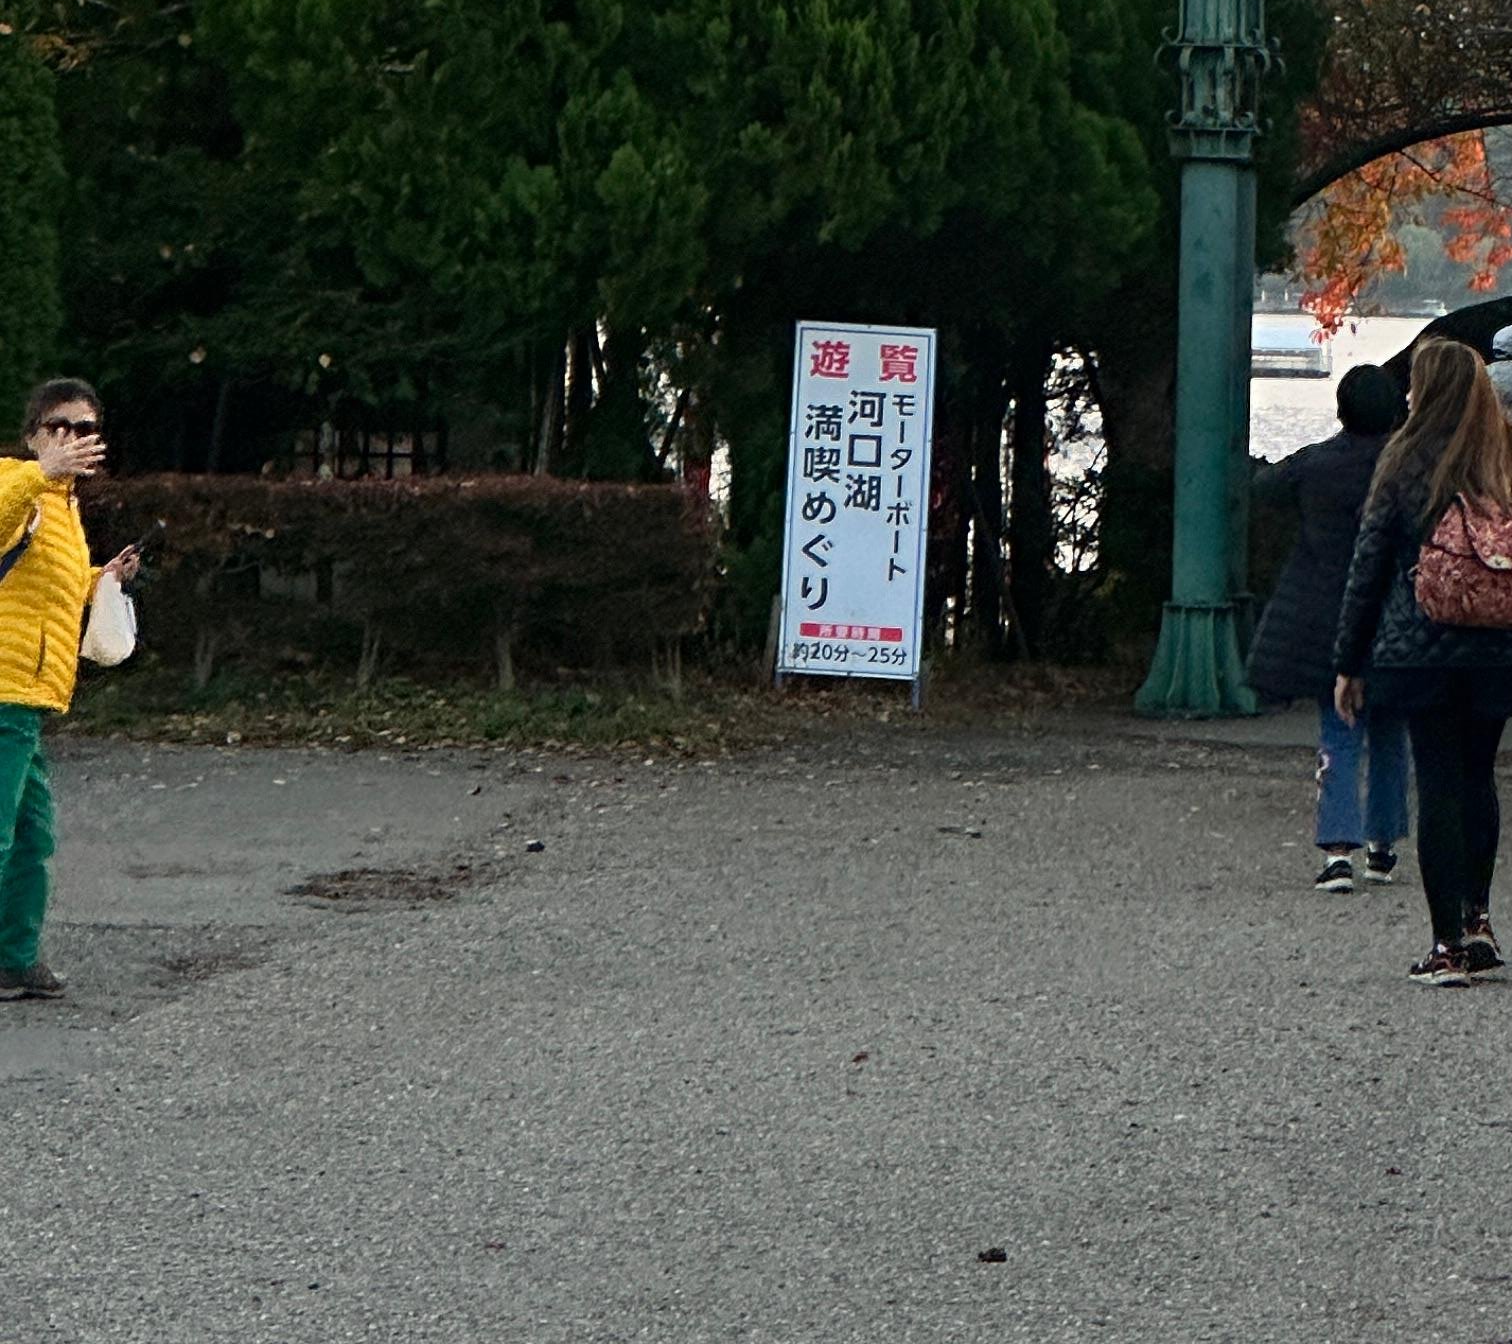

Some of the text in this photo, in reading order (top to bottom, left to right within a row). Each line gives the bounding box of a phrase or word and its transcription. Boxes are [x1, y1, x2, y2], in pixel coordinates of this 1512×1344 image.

[810, 340, 918, 383] 遊覧
[801, 404, 843, 610] 満喫めぐり
[844, 390, 886, 511] 河口湖
[886, 394, 916, 581] モーターボート
